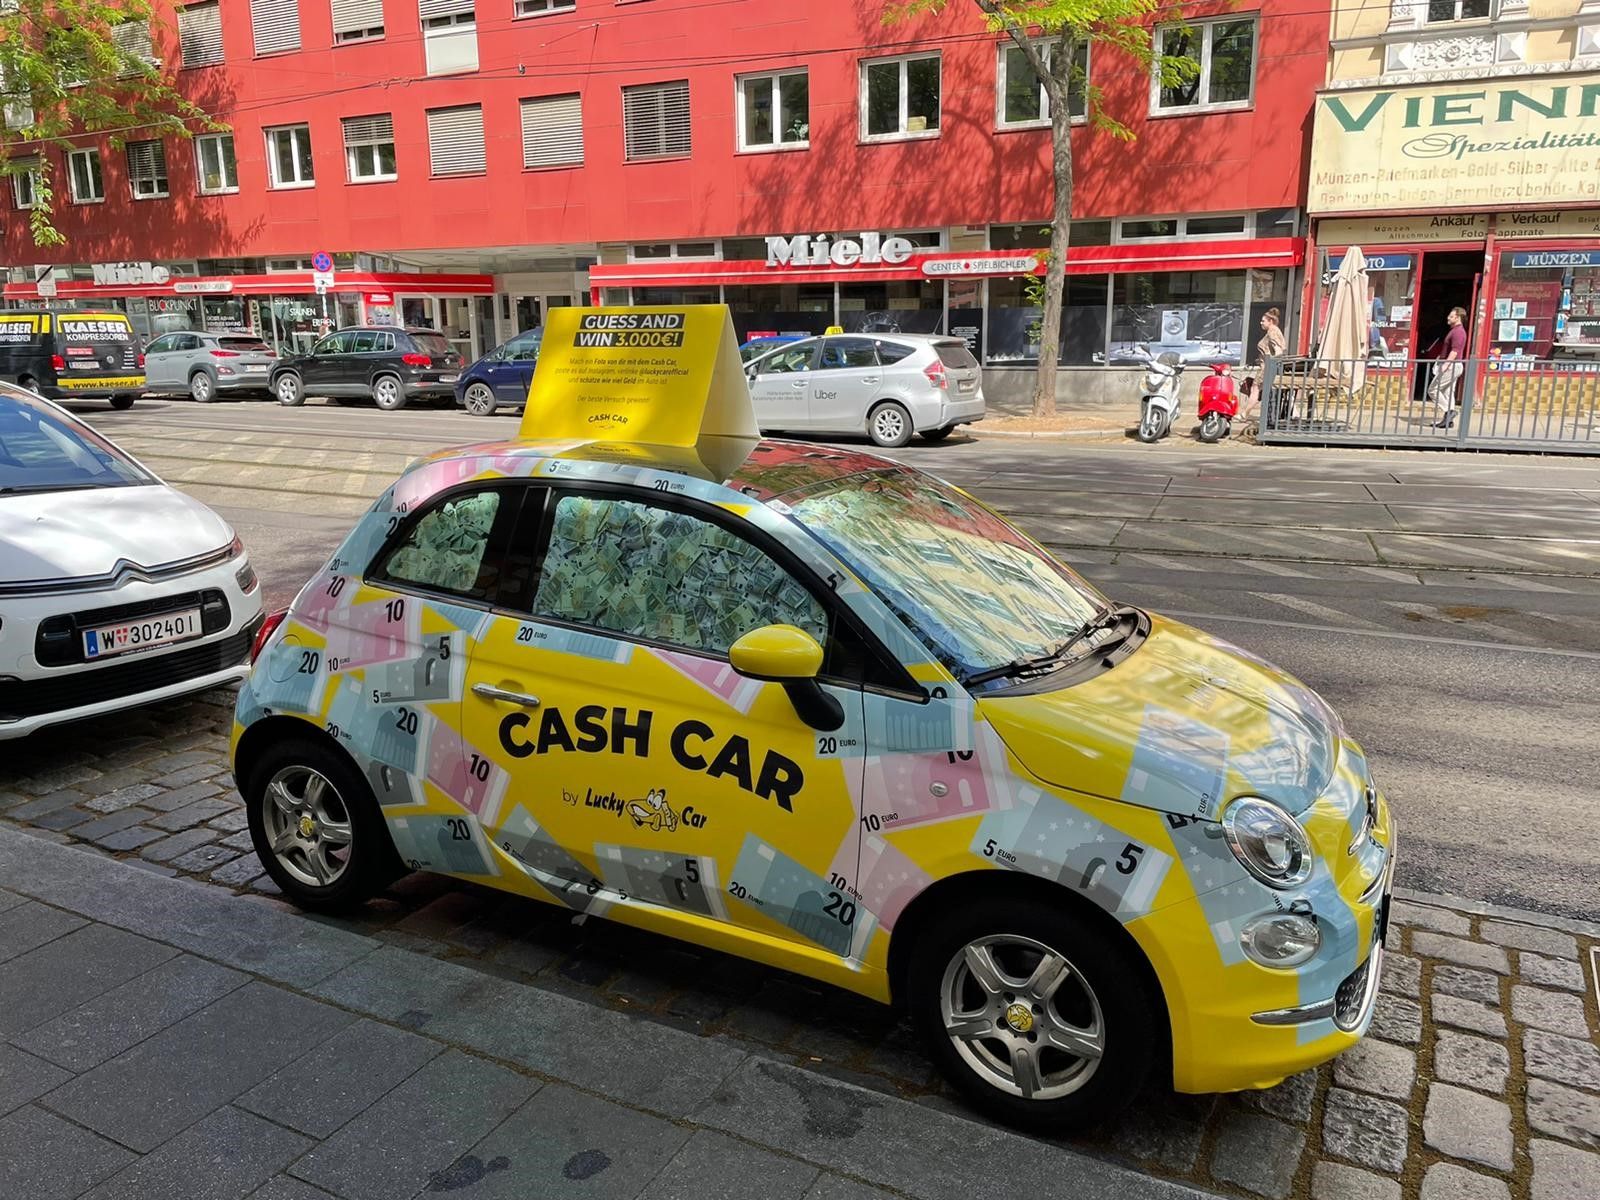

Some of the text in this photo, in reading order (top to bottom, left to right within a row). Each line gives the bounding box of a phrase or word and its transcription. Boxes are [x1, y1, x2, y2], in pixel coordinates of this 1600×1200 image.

[1431, 214, 1475, 227] Ankauf
[1511, 213, 1560, 224] Verkauf
[764, 231, 913, 267] Miele
[1526, 253, 1591, 265] MÜNZEN
[93, 262, 170, 285] Miele
[931, 259, 1027, 272] CENTER SPIELBICHLER
[63, 321, 127, 333] KAESER
[584, 313, 679, 330] GUESS AND
[66, 333, 129, 342] KOMPRESSOREN
[579, 331, 679, 347] WIN 3.000€!
[73, 381, 138, 389] www.kaeser.at
[814, 390, 837, 400] Uber
[588, 413, 628, 425] CASH CAR
[549, 461, 560, 473] 5
[326, 575, 346, 598] 10
[385, 599, 405, 623] 10
[101, 630, 116, 650] W
[517, 626, 548, 642] 20 EURO
[439, 636, 450, 660] 5
[298, 651, 319, 675] 20
[327, 657, 339, 672] 10
[372, 690, 380, 704] 5
[326, 722, 339, 738] 20
[396, 707, 418, 736] 20
[817, 736, 857, 755] 20 EURO
[469, 754, 490, 783] 10
[498, 705, 804, 814] CASH CAR
[562, 787, 708, 829] by Lucky Car
[447, 819, 471, 841] 20
[861, 811, 899, 832] 10 EURO
[982, 839, 1017, 863] 5 EURO
[1115, 842, 1144, 875] 5
[685, 859, 699, 883] 5
[728, 881, 747, 899] 20
[830, 872, 847, 892] 10
[822, 891, 857, 926] 20
